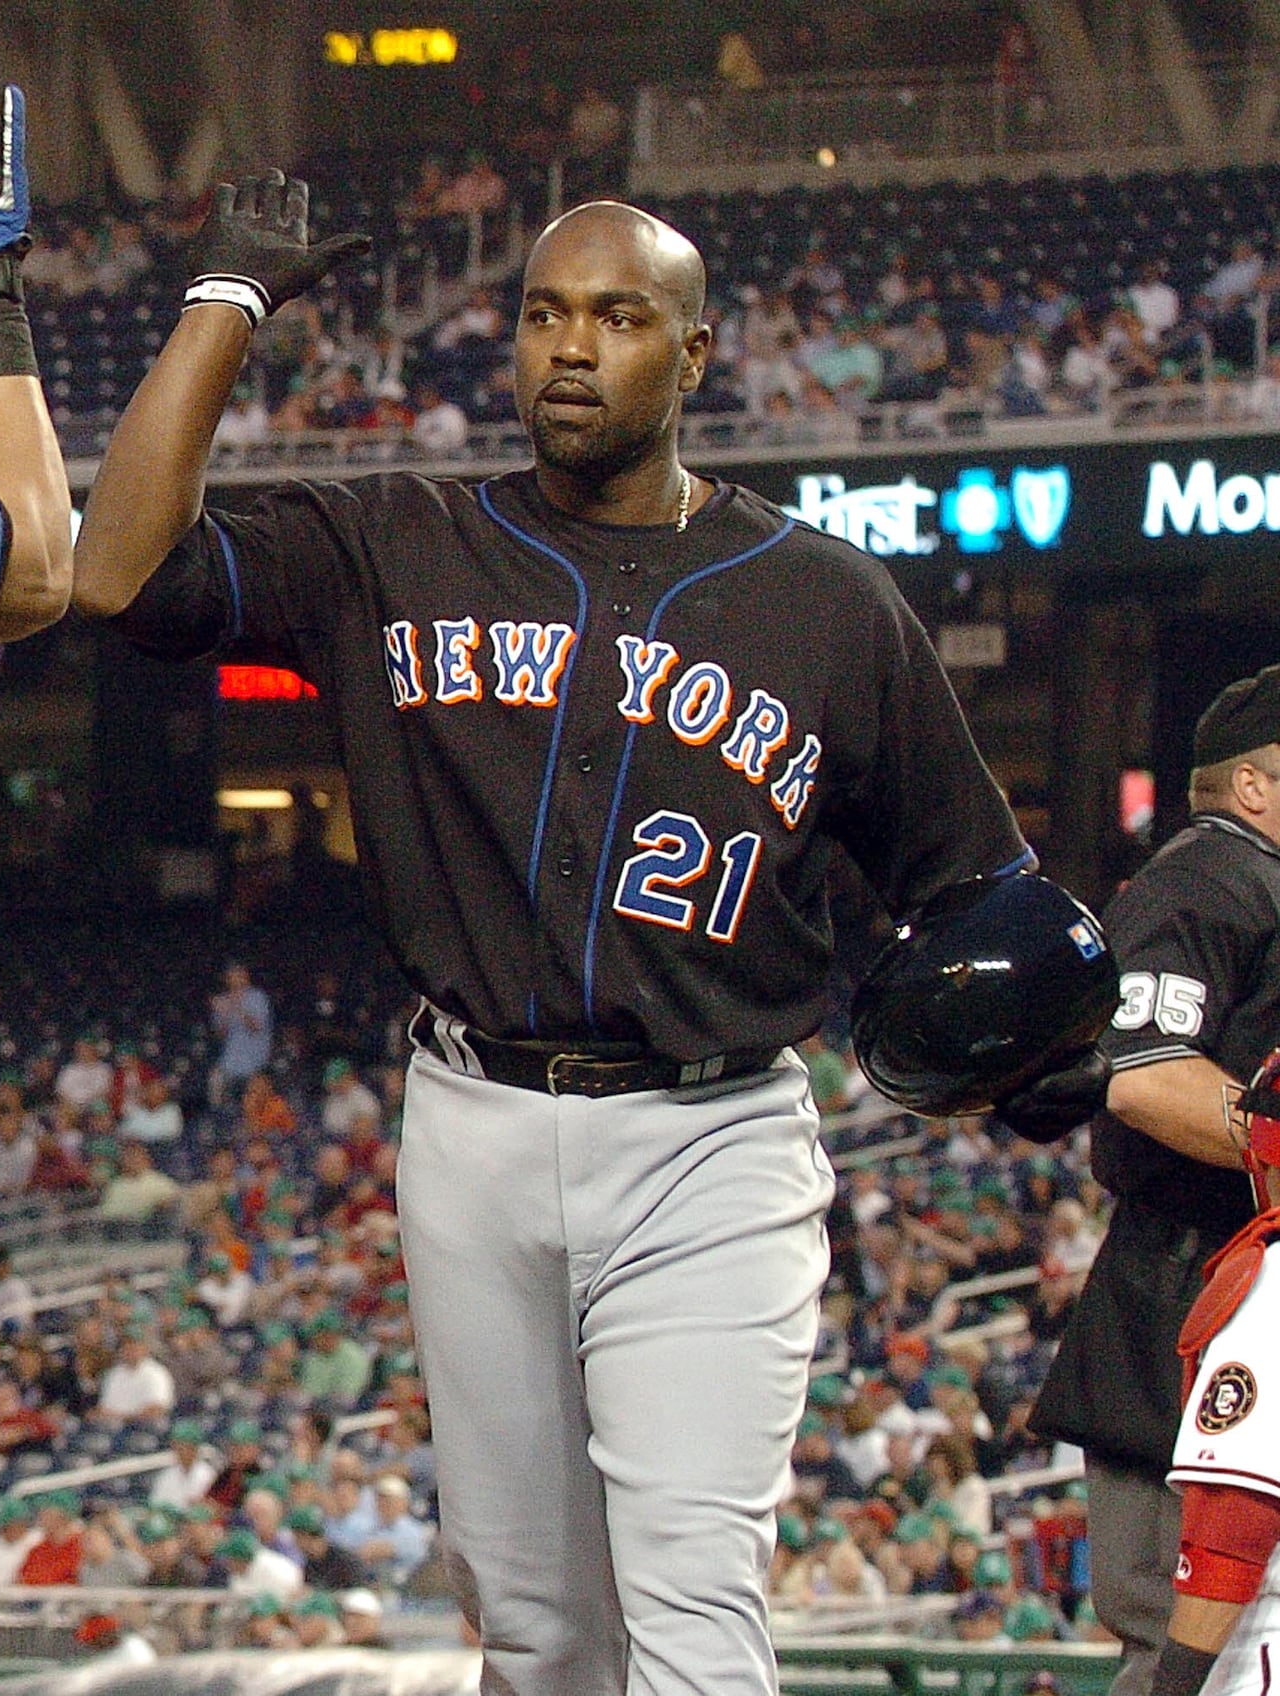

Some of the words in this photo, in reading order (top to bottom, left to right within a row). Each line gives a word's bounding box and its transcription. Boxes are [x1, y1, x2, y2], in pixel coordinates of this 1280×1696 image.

[384, 617, 576, 711] NEW
[613, 809, 762, 944] 21
[1111, 971, 1207, 1037] 35
